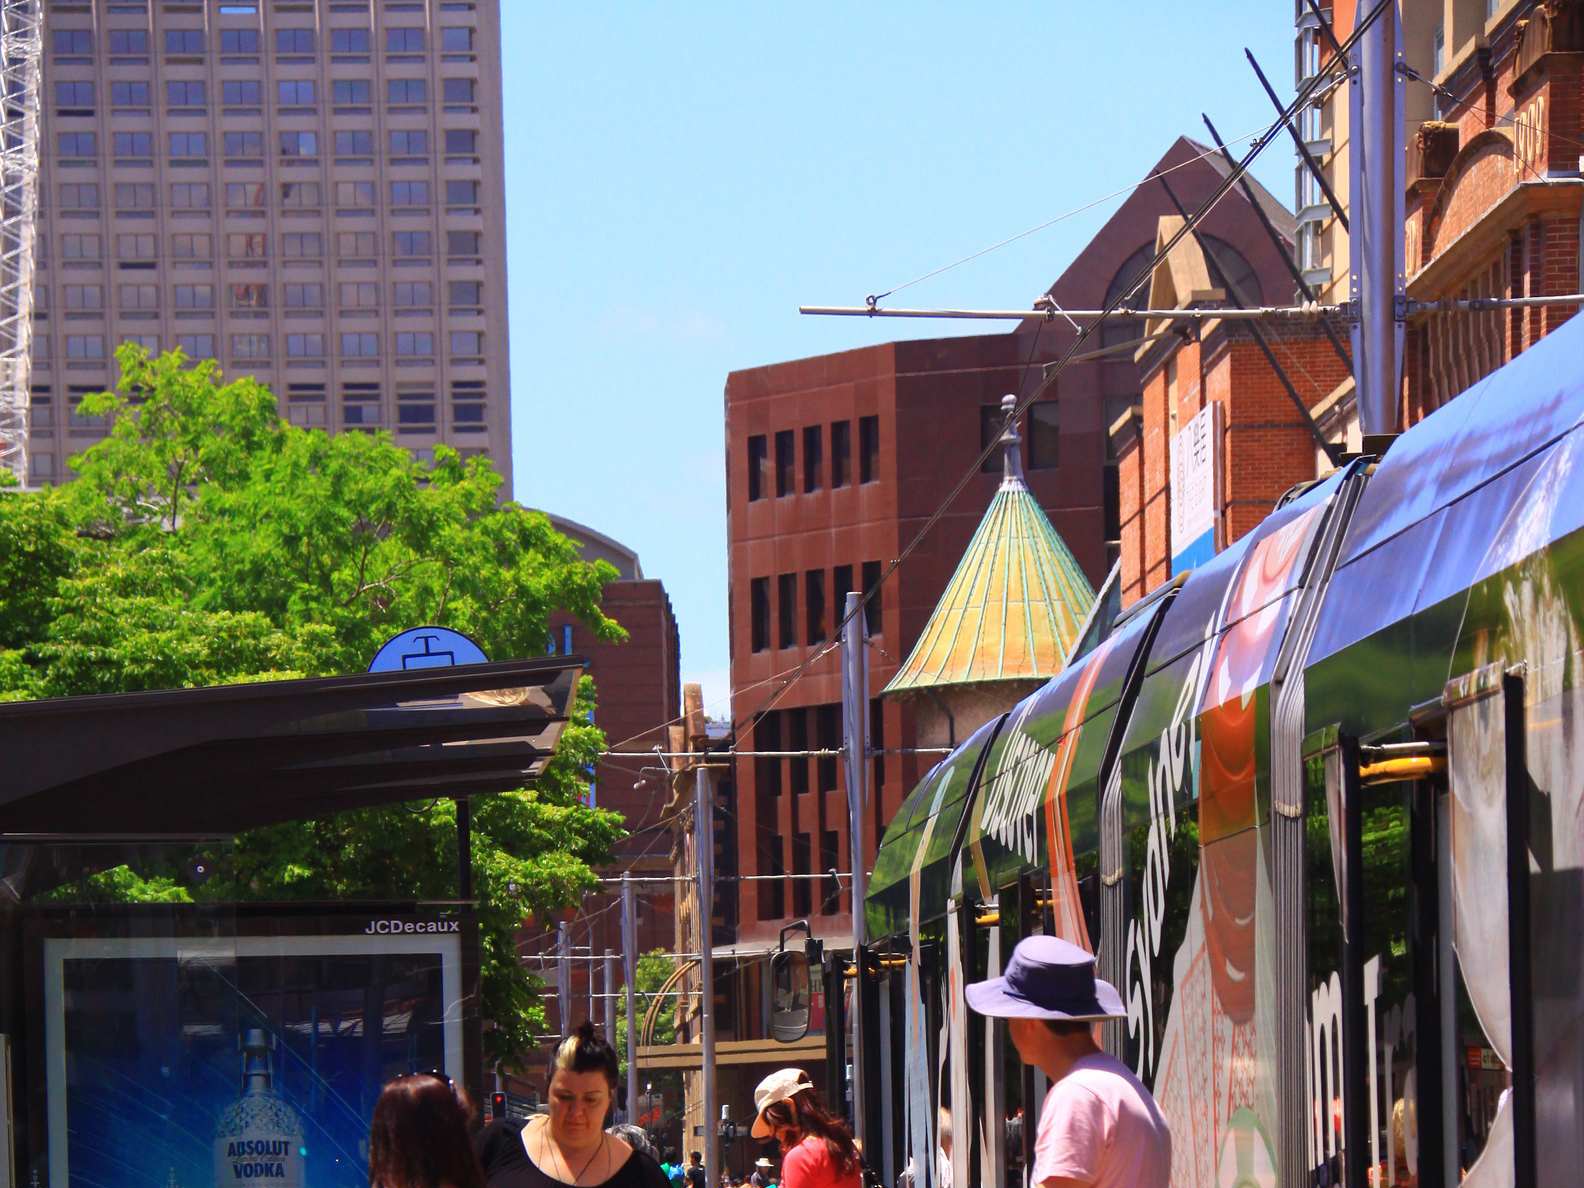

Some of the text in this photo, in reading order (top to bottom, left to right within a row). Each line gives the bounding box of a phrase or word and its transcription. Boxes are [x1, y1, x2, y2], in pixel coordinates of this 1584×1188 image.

[1513, 96, 1544, 175] 1909
[1126, 603, 1222, 1083] Sydney
[365, 920, 460, 934] JCDecaux
[227, 1140, 291, 1157] ABSOLUT
[233, 1162, 285, 1178] VODKA
